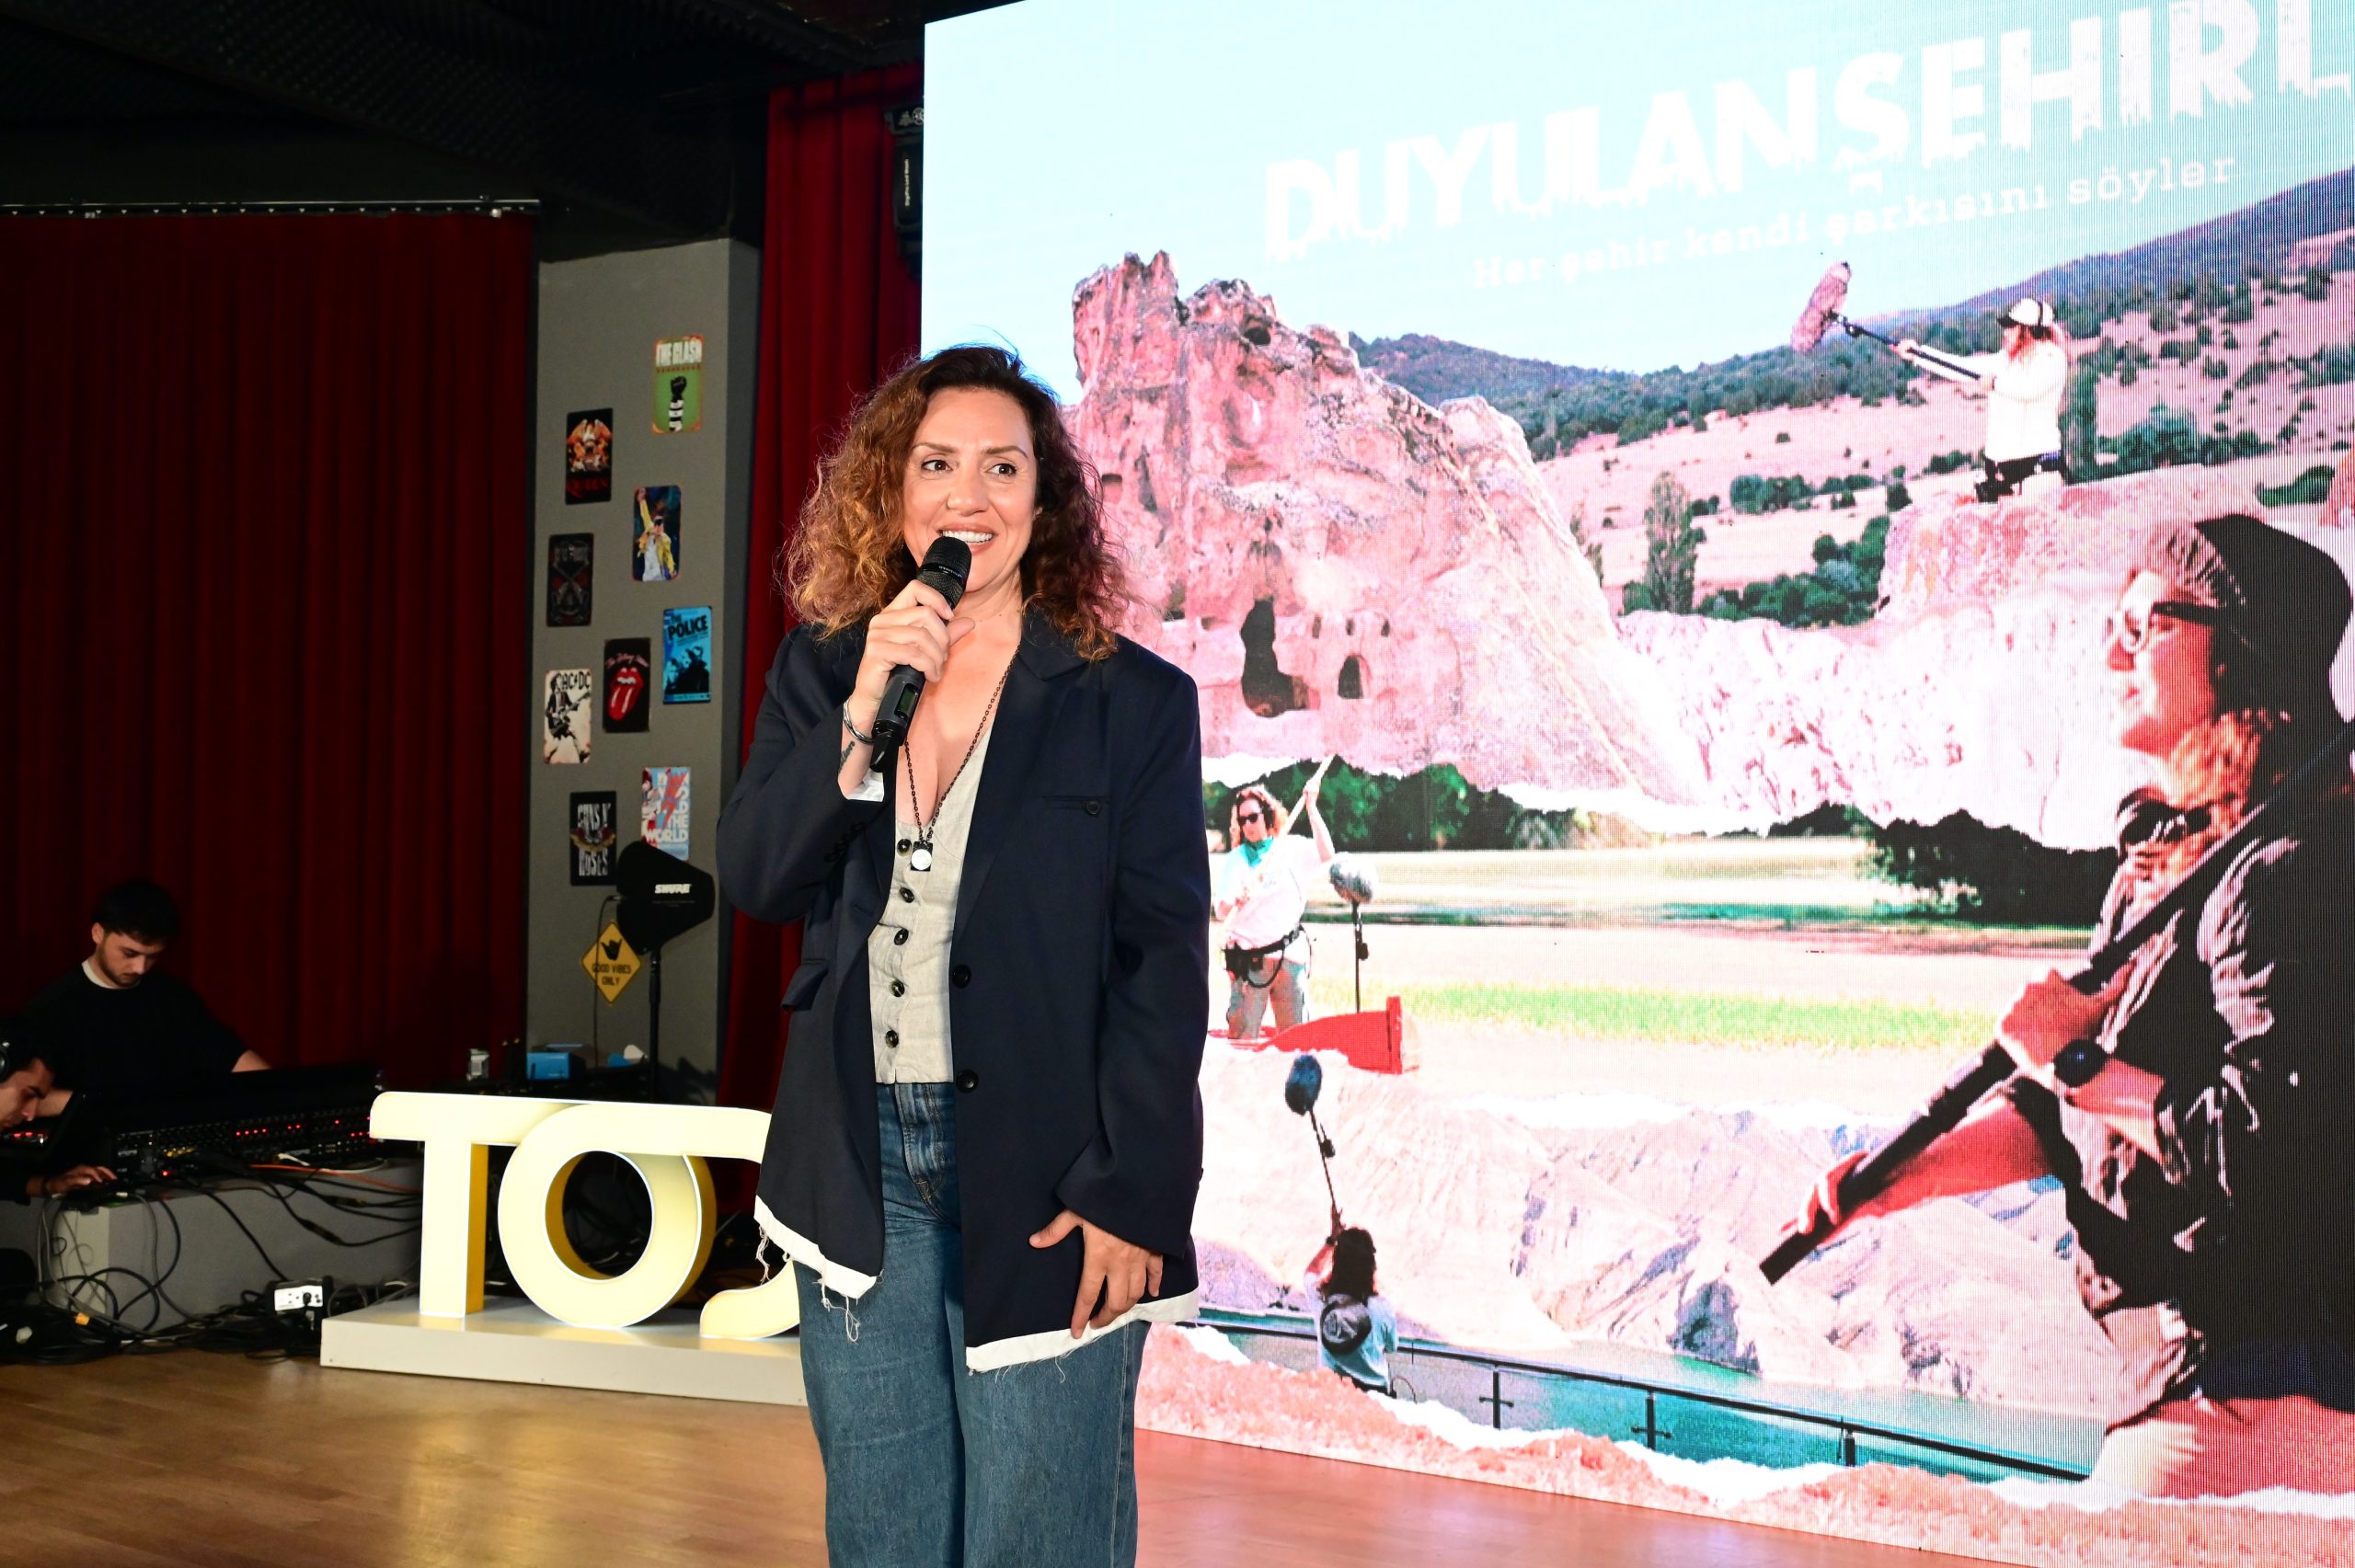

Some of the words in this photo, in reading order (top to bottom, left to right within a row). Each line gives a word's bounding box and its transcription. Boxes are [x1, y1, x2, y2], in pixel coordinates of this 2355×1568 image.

[1472, 256, 1545, 290] Her
[1560, 235, 1671, 282] şehir
[1683, 212, 1810, 259] kendi
[1826, 184, 2049, 246] şarkısını
[2067, 155, 2236, 206] söyler
[667, 614, 708, 641] POLICE
[654, 884, 692, 894] SHURE
